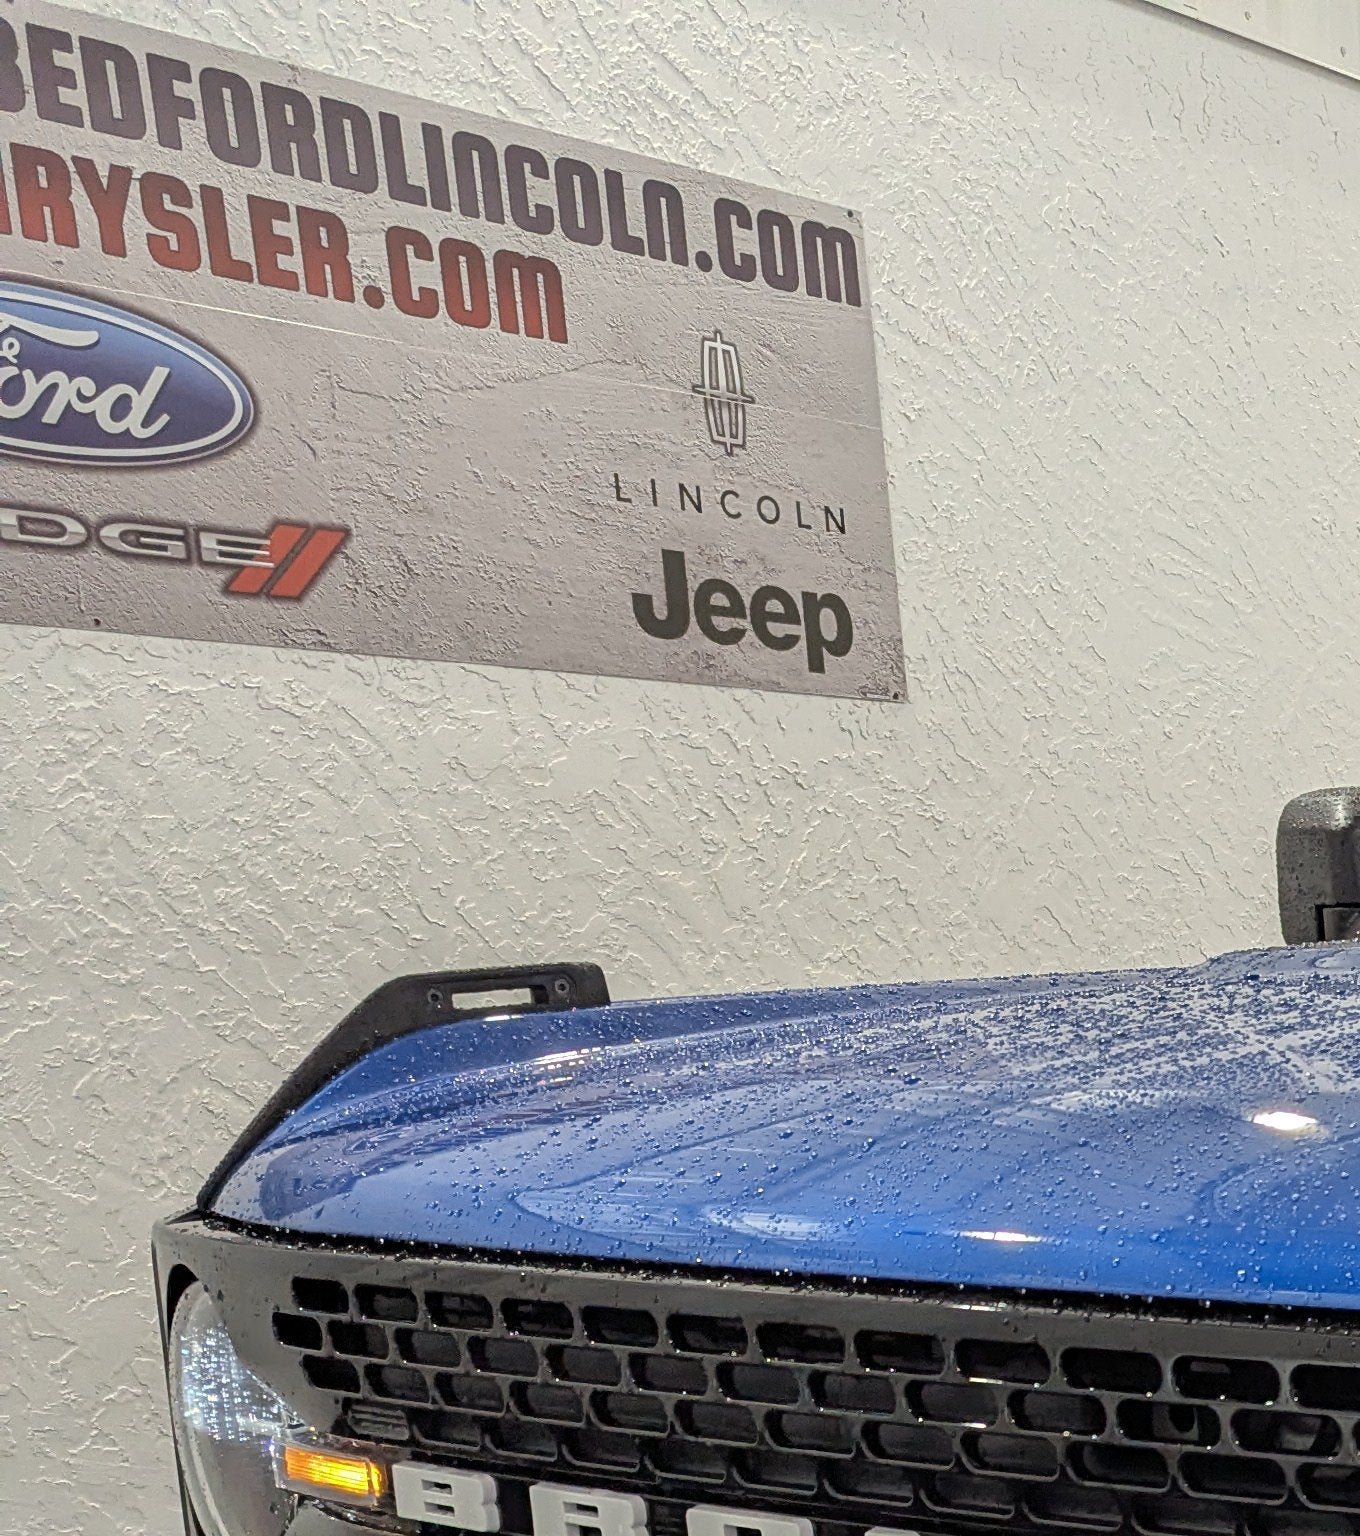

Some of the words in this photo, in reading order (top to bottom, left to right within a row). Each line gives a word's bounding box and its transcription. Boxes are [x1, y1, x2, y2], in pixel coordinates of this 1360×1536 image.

[0, 143, 568, 344] RYSLER.COM
[613, 473, 846, 534] LINCOLN
[631, 549, 853, 673] Jeep
